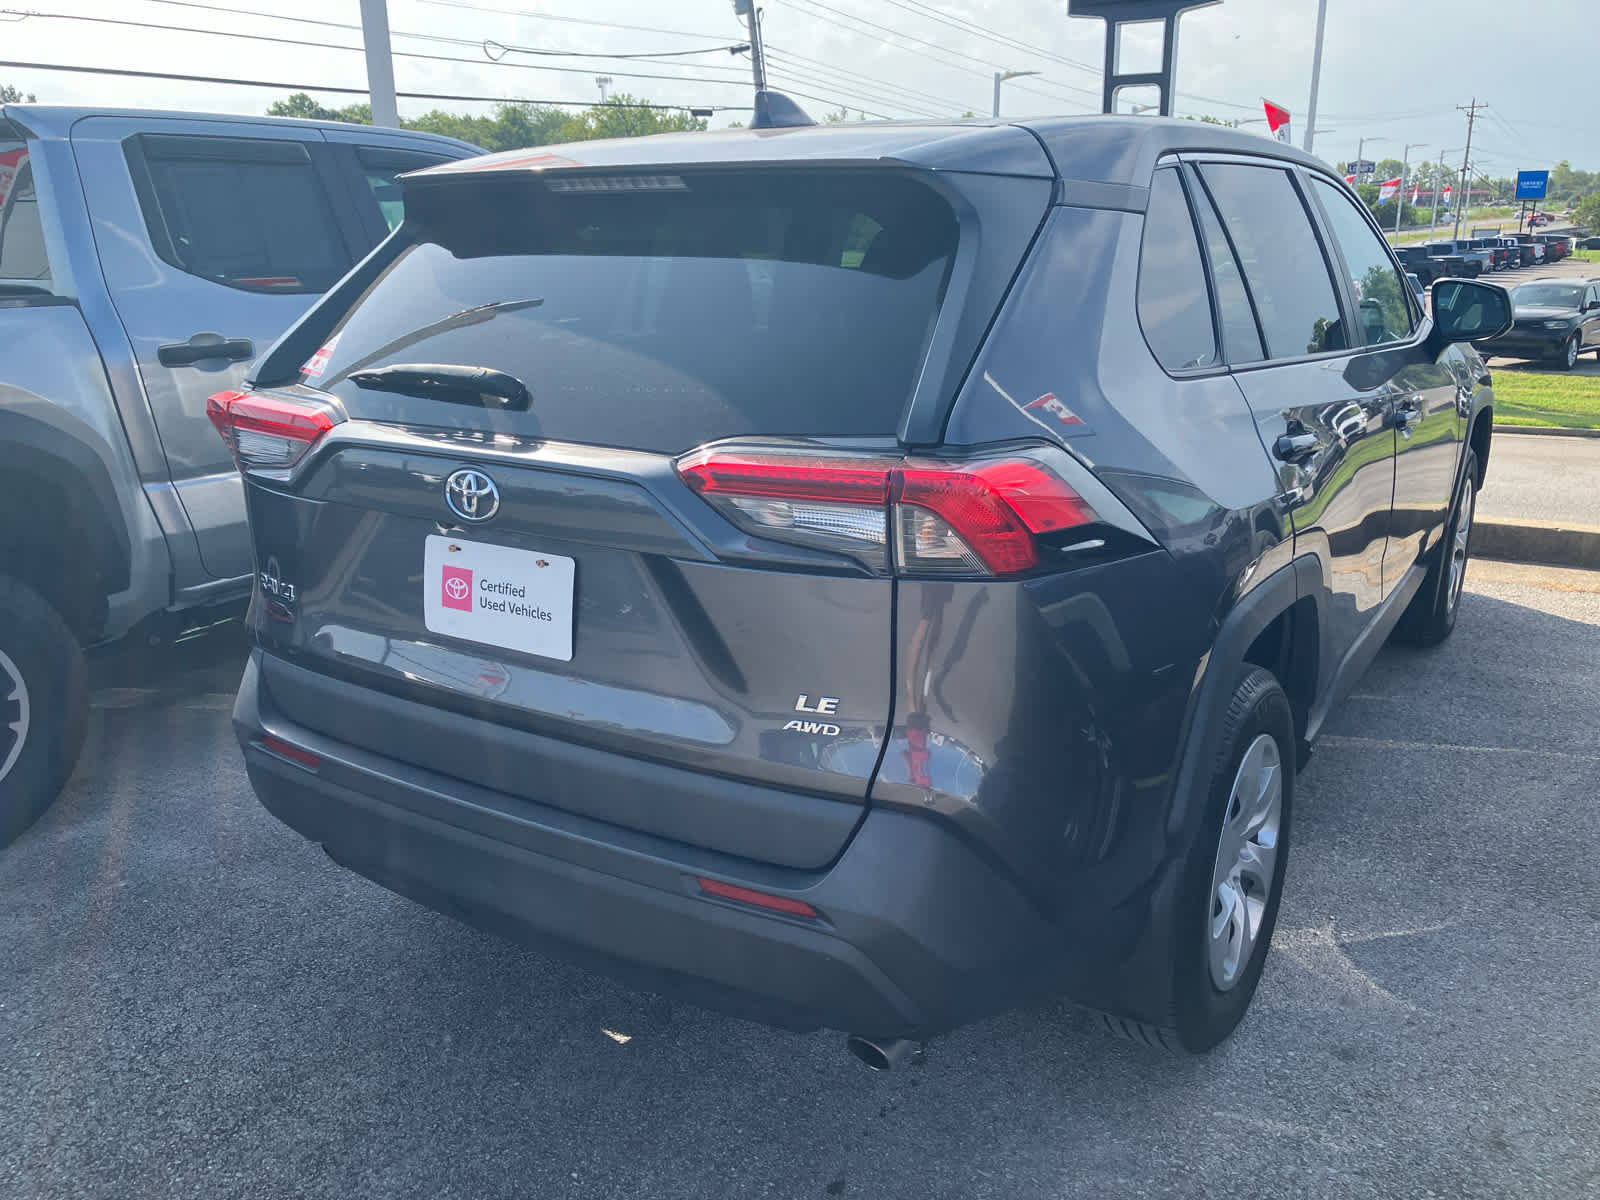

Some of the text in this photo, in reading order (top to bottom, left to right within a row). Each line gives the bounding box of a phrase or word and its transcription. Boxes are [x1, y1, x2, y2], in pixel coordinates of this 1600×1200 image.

[480, 579, 525, 598] Certified
[480, 596, 552, 621] Used Vehicles
[795, 693, 840, 715] LE
[782, 720, 840, 736] AWD
